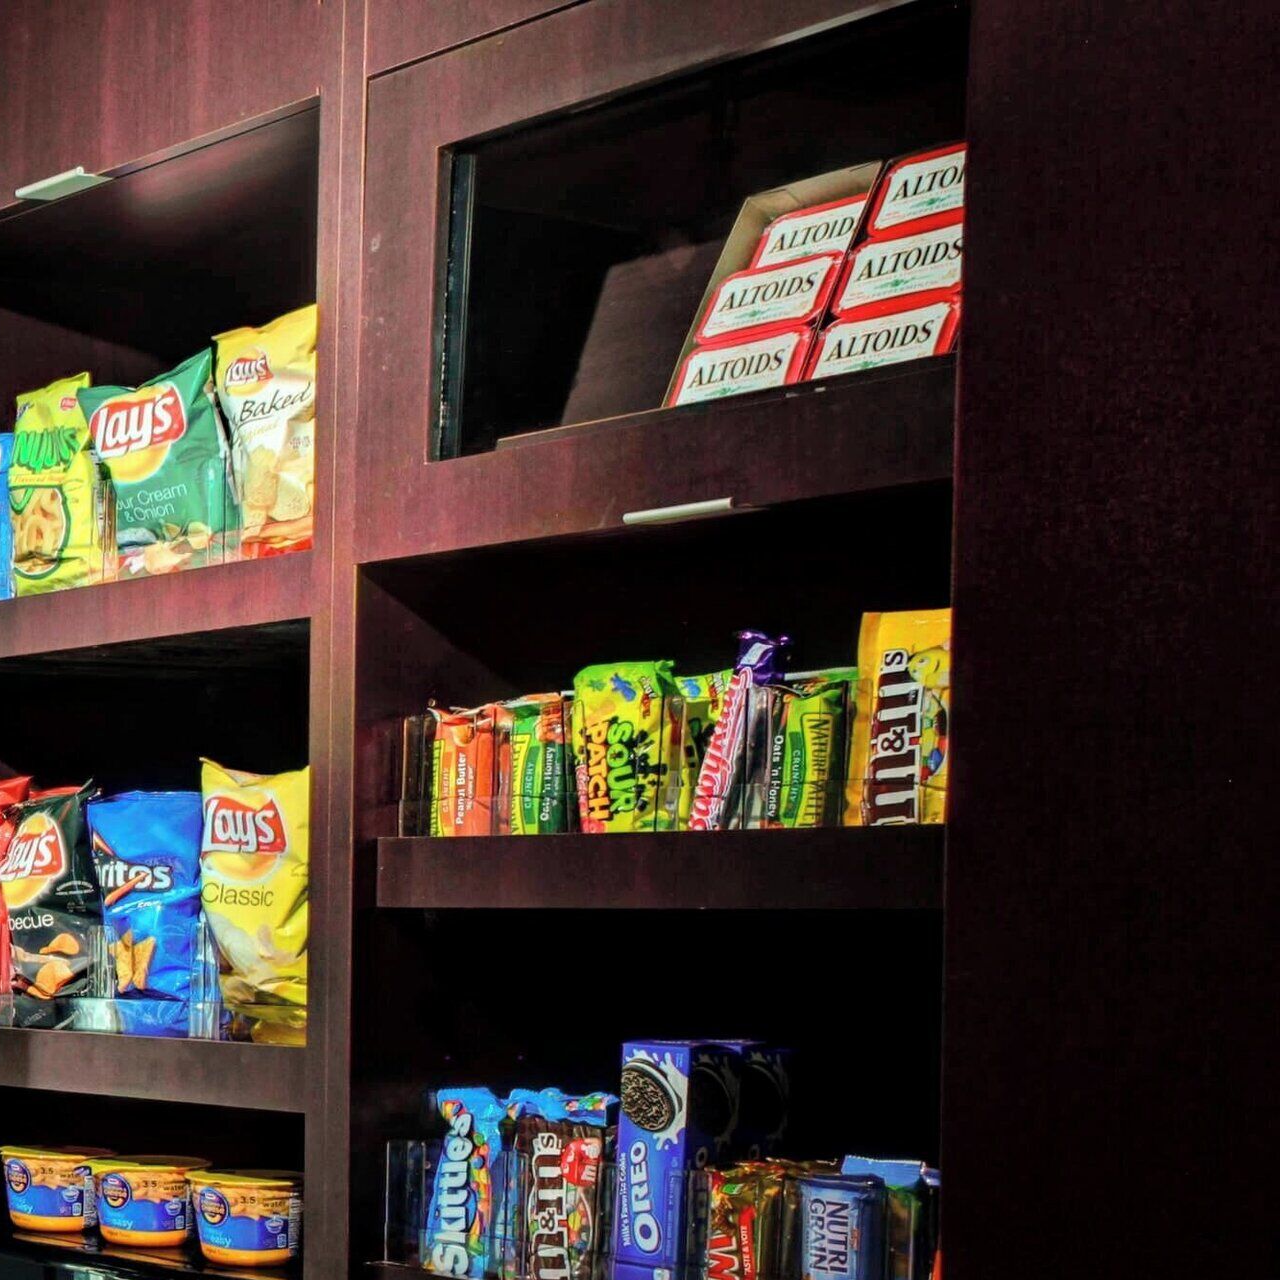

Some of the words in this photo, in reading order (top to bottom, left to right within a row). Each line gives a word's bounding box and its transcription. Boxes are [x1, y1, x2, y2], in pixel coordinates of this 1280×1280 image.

[890, 166, 964, 203] ALTOI
[769, 216, 858, 254] ALTOID
[720, 271, 820, 312] ALTOIDS
[826, 319, 935, 363] ALTOIDS
[688, 349, 785, 389] ALTOIDS
[240, 381, 312, 422] Baked
[94, 388, 176, 459] Lay's
[116, 495, 135, 511] our
[137, 482, 188, 504] Cream
[124, 511, 133, 522] &
[134, 502, 175, 521] Onion
[543, 746, 556, 780] Honey
[607, 720, 637, 813] SOUR
[772, 735, 785, 763] Oats
[456, 752, 467, 786] Butter
[584, 719, 610, 821] PATCH
[455, 787, 466, 825] Peanut
[767, 780, 780, 817] Honey
[202, 797, 276, 853] Lay's
[96, 860, 172, 890] ritos
[201, 881, 274, 908] Classic
[7, 912, 55, 931] becue
[431, 1112, 474, 1276] Skittles
[630, 1141, 663, 1256] OREO
[623, 1222, 632, 1248] Milk's
[740, 1225, 749, 1245] VOTE
[809, 1198, 829, 1272] GRAIN
[825, 1200, 850, 1275] NUTRI
